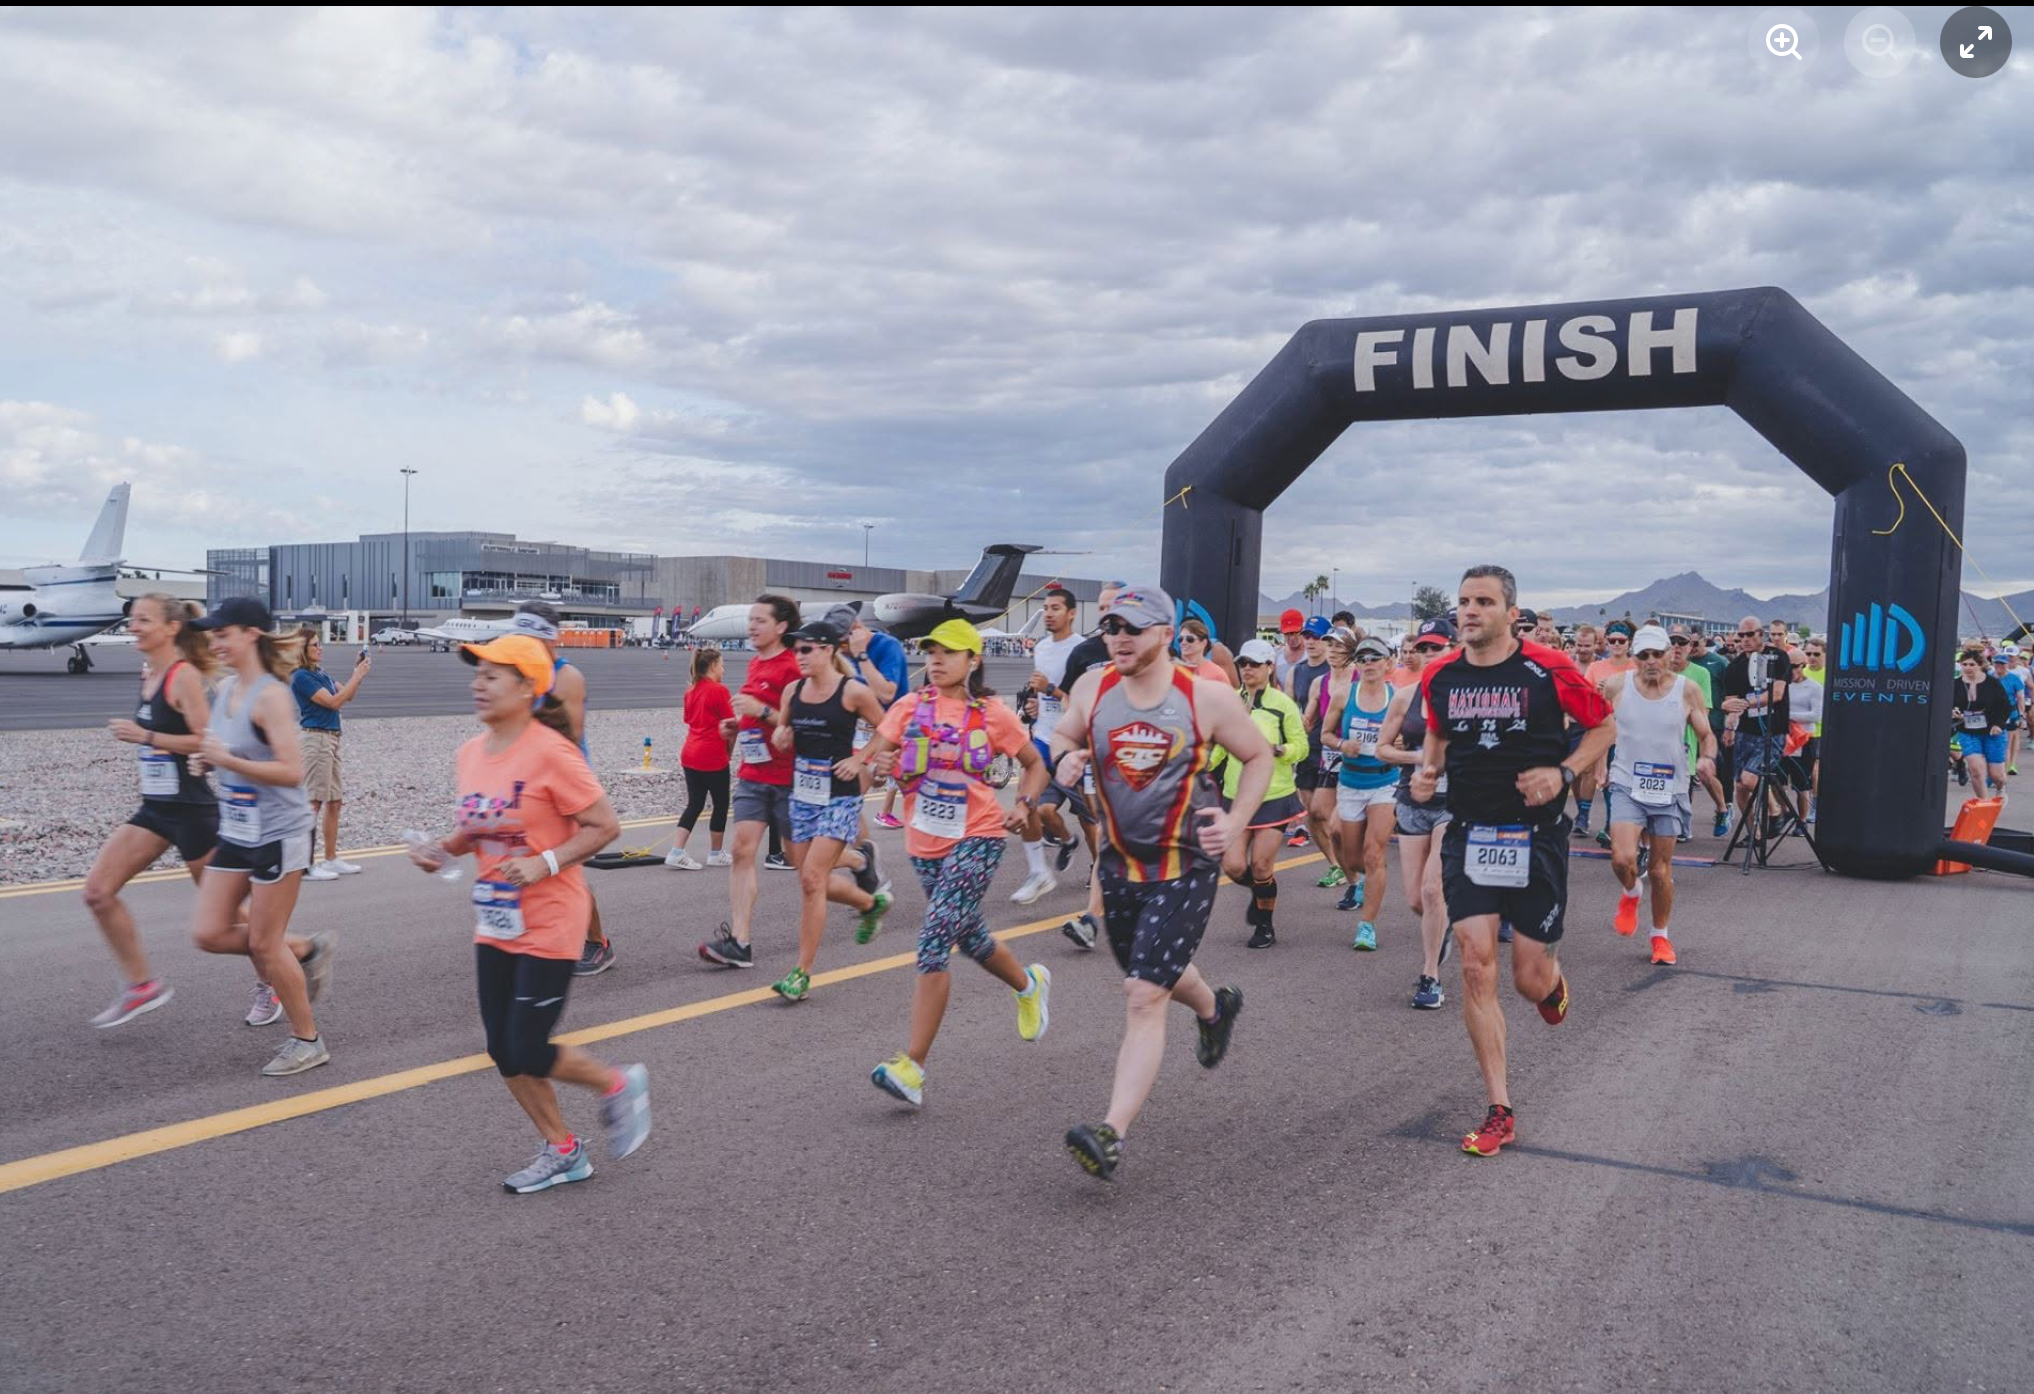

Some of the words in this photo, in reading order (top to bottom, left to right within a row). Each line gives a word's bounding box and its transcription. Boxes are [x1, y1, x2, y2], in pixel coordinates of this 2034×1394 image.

[1354, 307, 1699, 392] FINISH
[1833, 678, 1876, 689] MISSION
[1886, 680, 1930, 691] DRIVEN
[1448, 691, 1520, 708] NATIONAL
[1832, 691, 1928, 704] EVENTS
[1640, 777, 1666, 791] 2023
[922, 799, 956, 820] 2223
[1478, 847, 1518, 866] 2063
